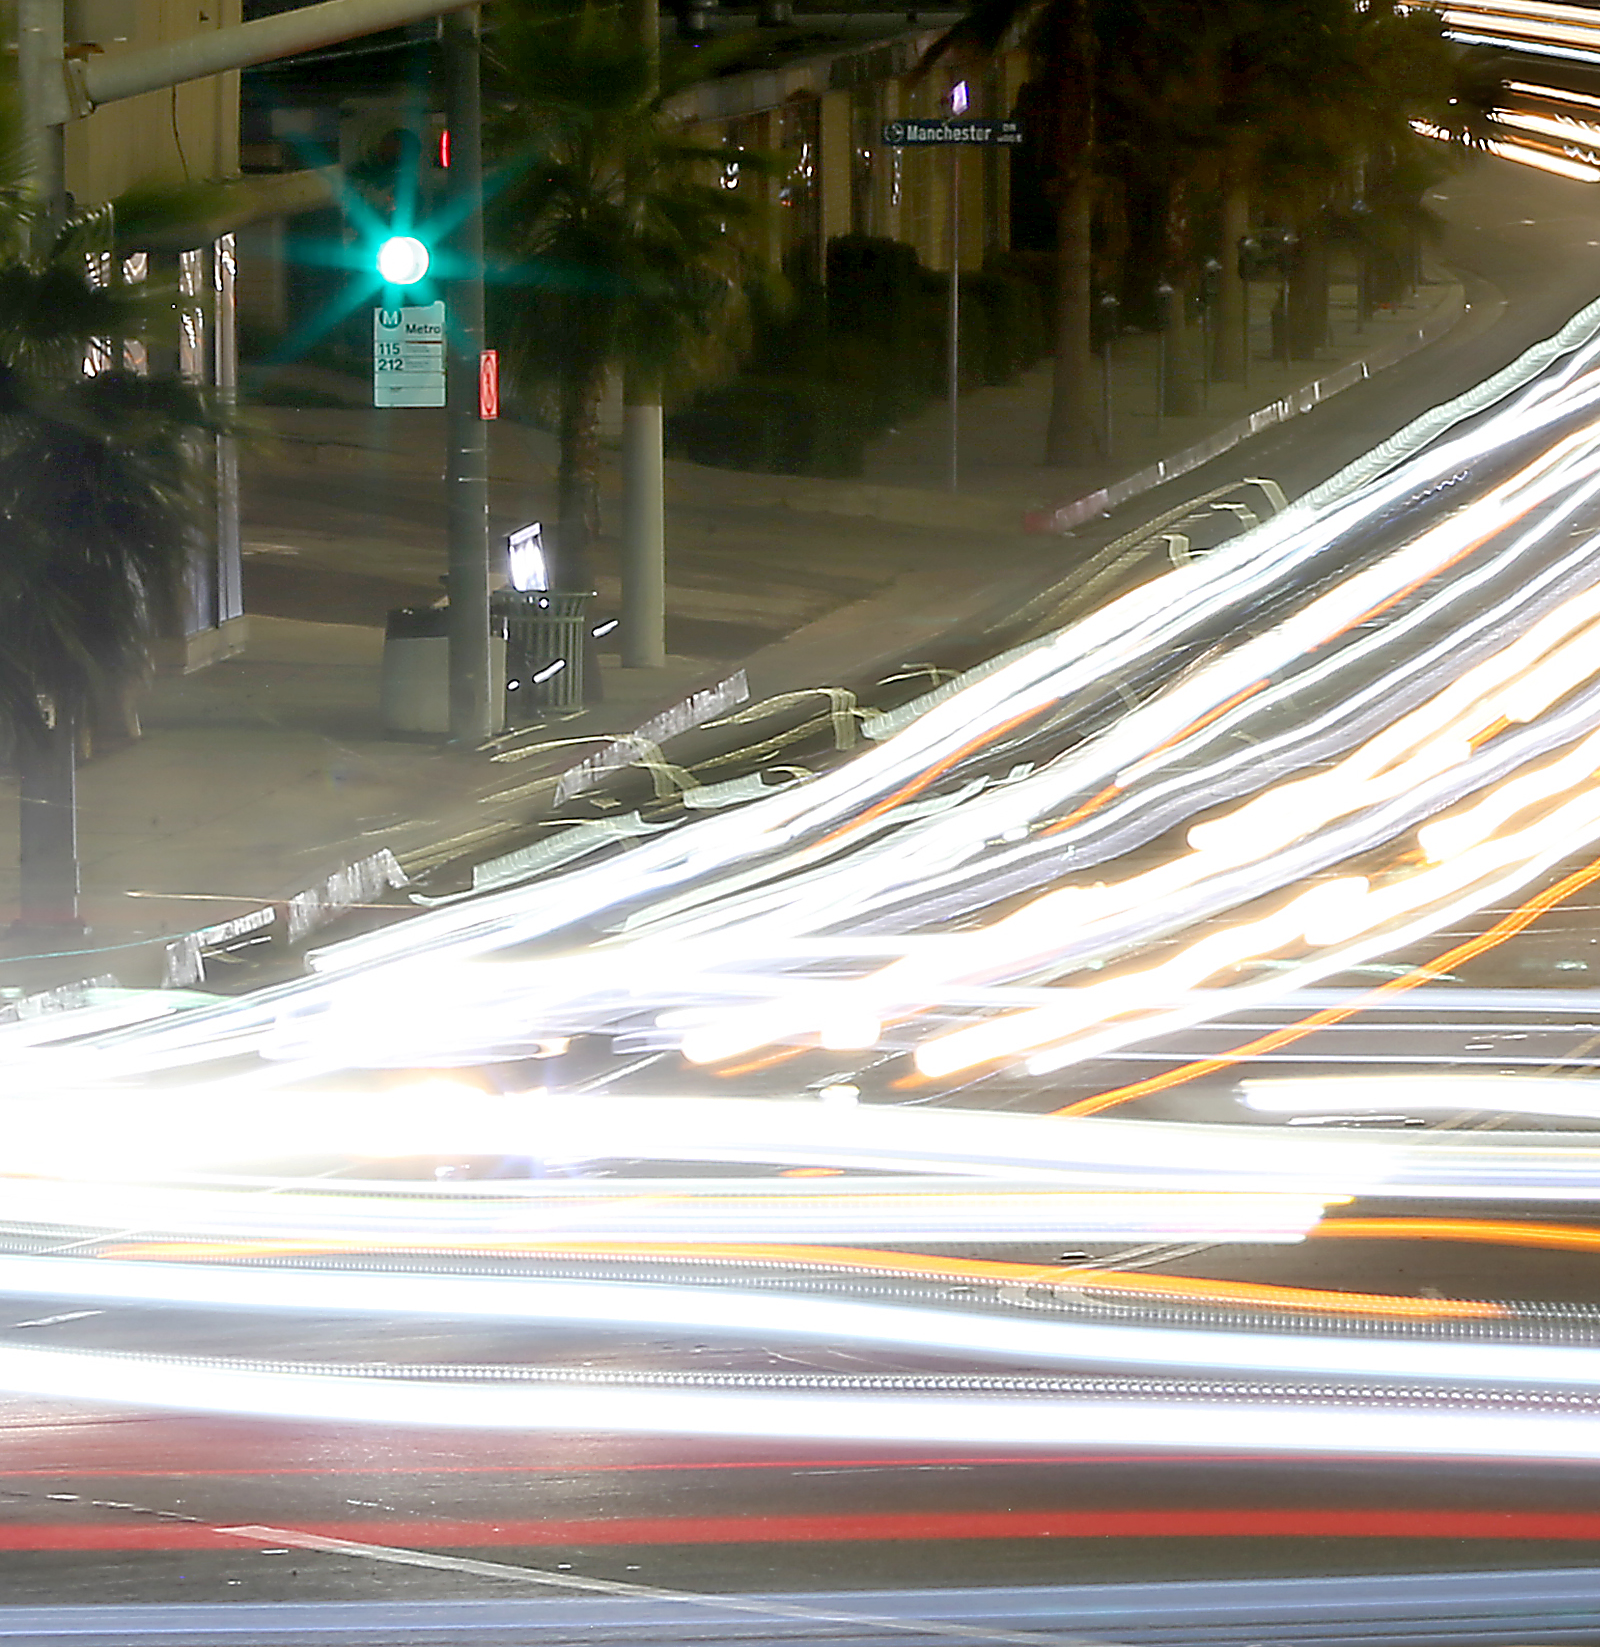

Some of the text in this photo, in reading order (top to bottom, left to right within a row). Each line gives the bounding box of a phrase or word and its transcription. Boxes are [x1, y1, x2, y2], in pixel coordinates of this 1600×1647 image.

[906, 124, 992, 141] Manchester
[405, 323, 442, 335] Metro
[378, 343, 401, 356] 115
[377, 358, 404, 371] 212
